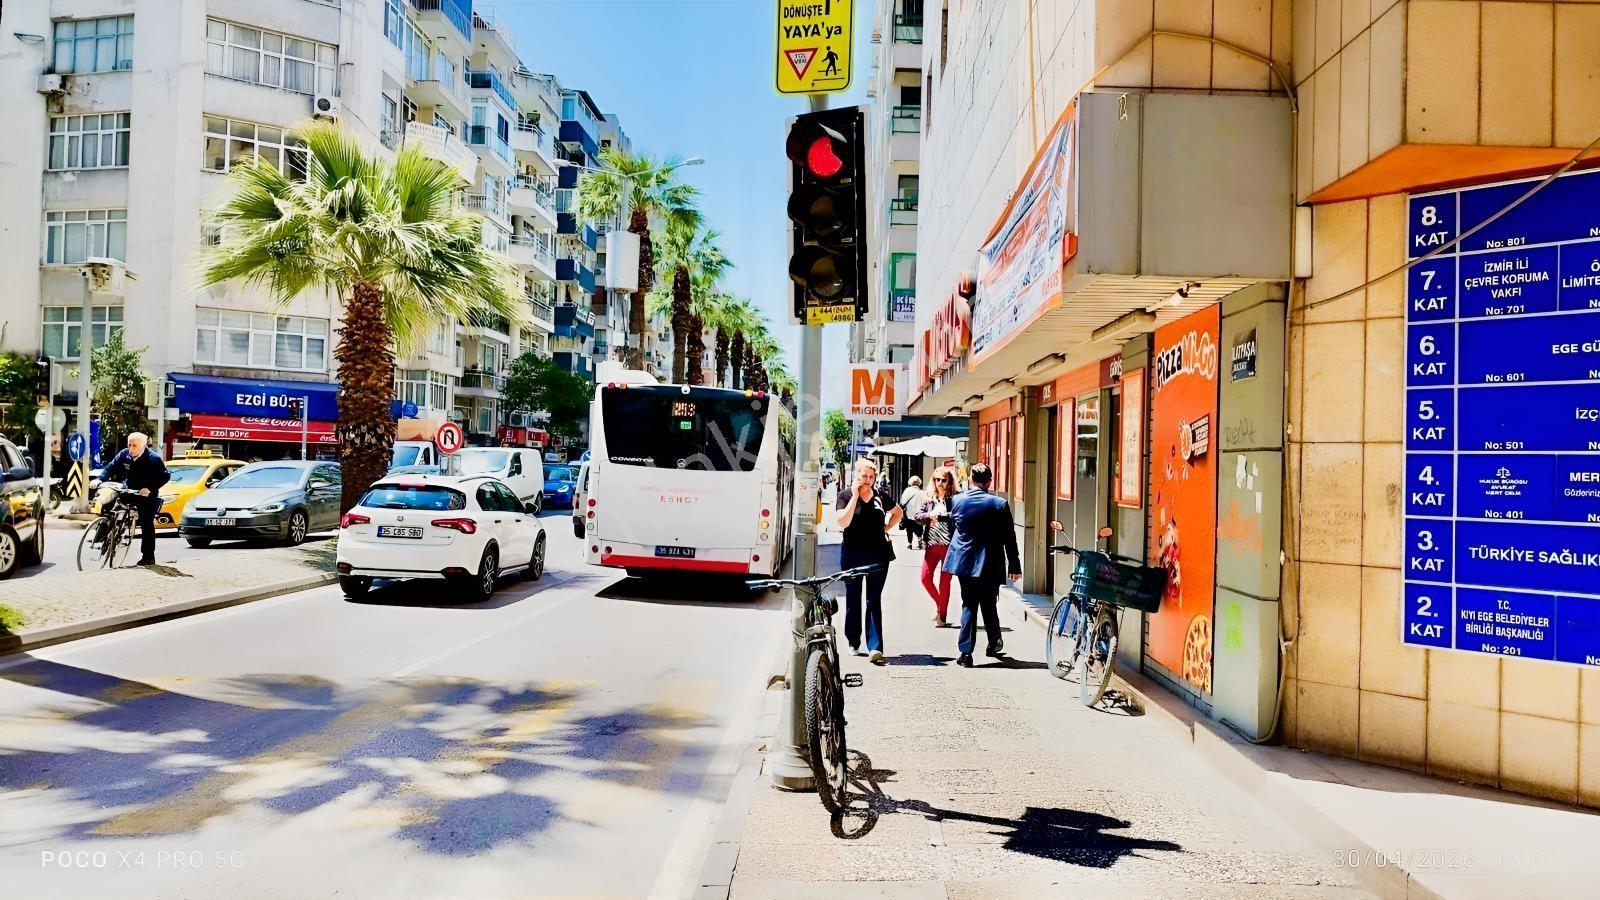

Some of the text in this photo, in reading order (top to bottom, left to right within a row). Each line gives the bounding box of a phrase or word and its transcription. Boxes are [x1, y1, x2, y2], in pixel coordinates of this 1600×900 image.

[783, 4, 823, 19] DÖNÜŞTE
[783, 22, 842, 39] YAYA'ya
[1422, 206, 1442, 226] 8.
[1415, 231, 1448, 247] KAT
[1486, 237, 1526, 249] No: 801
[1484, 257, 1529, 272] İZMİR İLİ
[1420, 270, 1442, 290] 7.
[1464, 272, 1549, 290] ÇEVRE KORUMA
[1491, 287, 1522, 298] VAKFI
[1414, 297, 1447, 311] KAT
[1486, 305, 1525, 315] No: 701
[1419, 336, 1441, 356] 6.
[1552, 343, 1579, 354] EGE
[1413, 362, 1446, 376] KAT
[1486, 373, 1525, 382] No: 601
[236, 392, 304, 409] EZGİ BÜE
[1418, 400, 1440, 420] 5.
[1412, 427, 1446, 440] KAT
[1484, 441, 1524, 450] No: 501
[1418, 465, 1440, 486] 4.
[1412, 493, 1446, 506] KAT
[1484, 509, 1524, 519] No: 401
[1417, 530, 1439, 550] 3.
[1469, 545, 1534, 562] TÜRKİYE
[1411, 557, 1444, 572] KAT
[1416, 596, 1438, 618] 2.
[1497, 600, 1512, 610] T.C.
[1461, 610, 1549, 628] KIYI EGE BELEDİYELER
[1410, 622, 1444, 638] KAT
[1465, 622, 1544, 641] BİRLİĞİ BAŞKANLIĞI
[1481, 643, 1521, 656] No: 201
